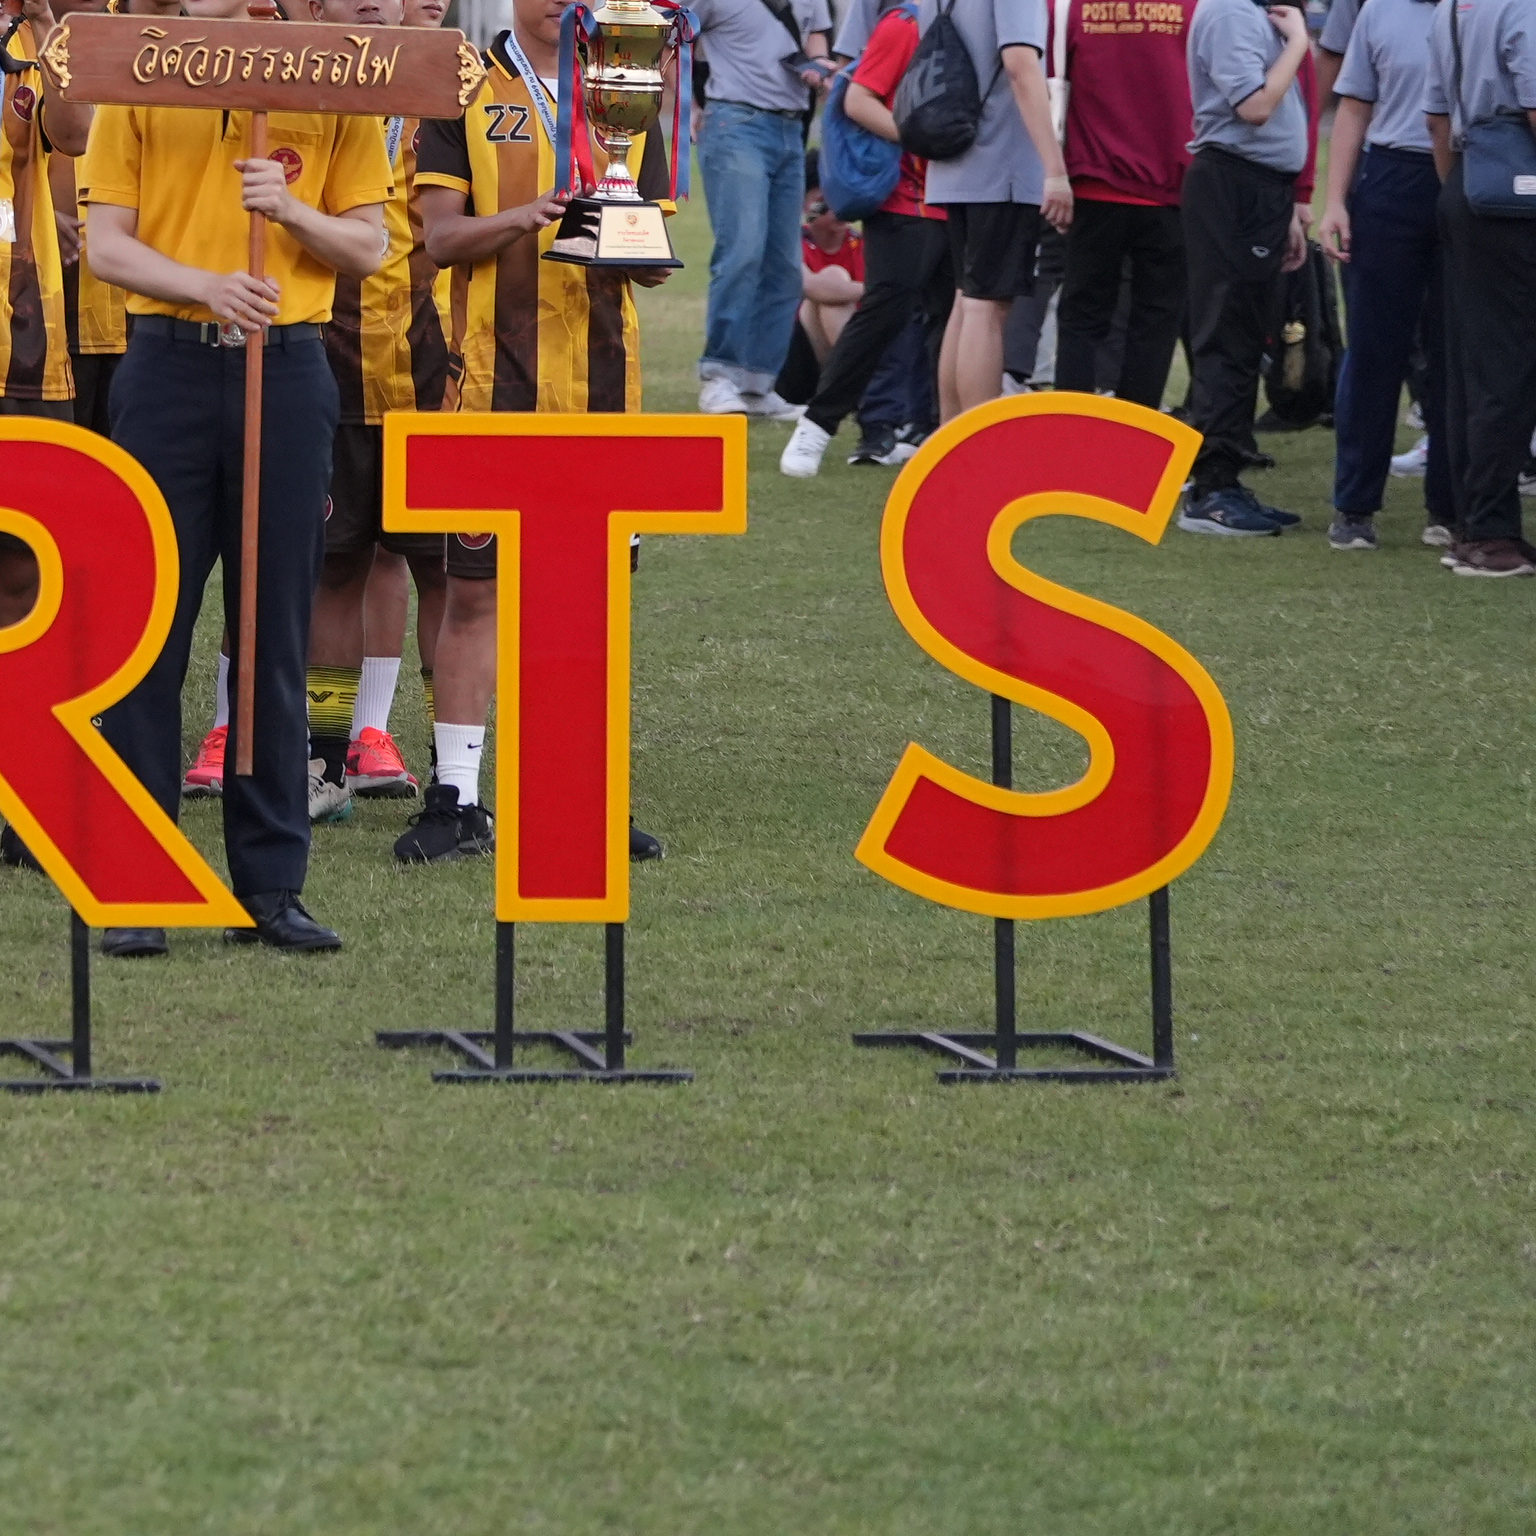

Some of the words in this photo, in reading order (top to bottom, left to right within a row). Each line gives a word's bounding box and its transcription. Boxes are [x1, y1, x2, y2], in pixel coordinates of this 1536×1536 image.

[1082, 1, 1131, 21] POSTAL
[1134, 2, 1183, 23] SCHOOL
[132, 25, 403, 88] วิศวกรรมรถไฟ
[531, 83, 543, 101] 2569
[483, 103, 533, 144] 22
